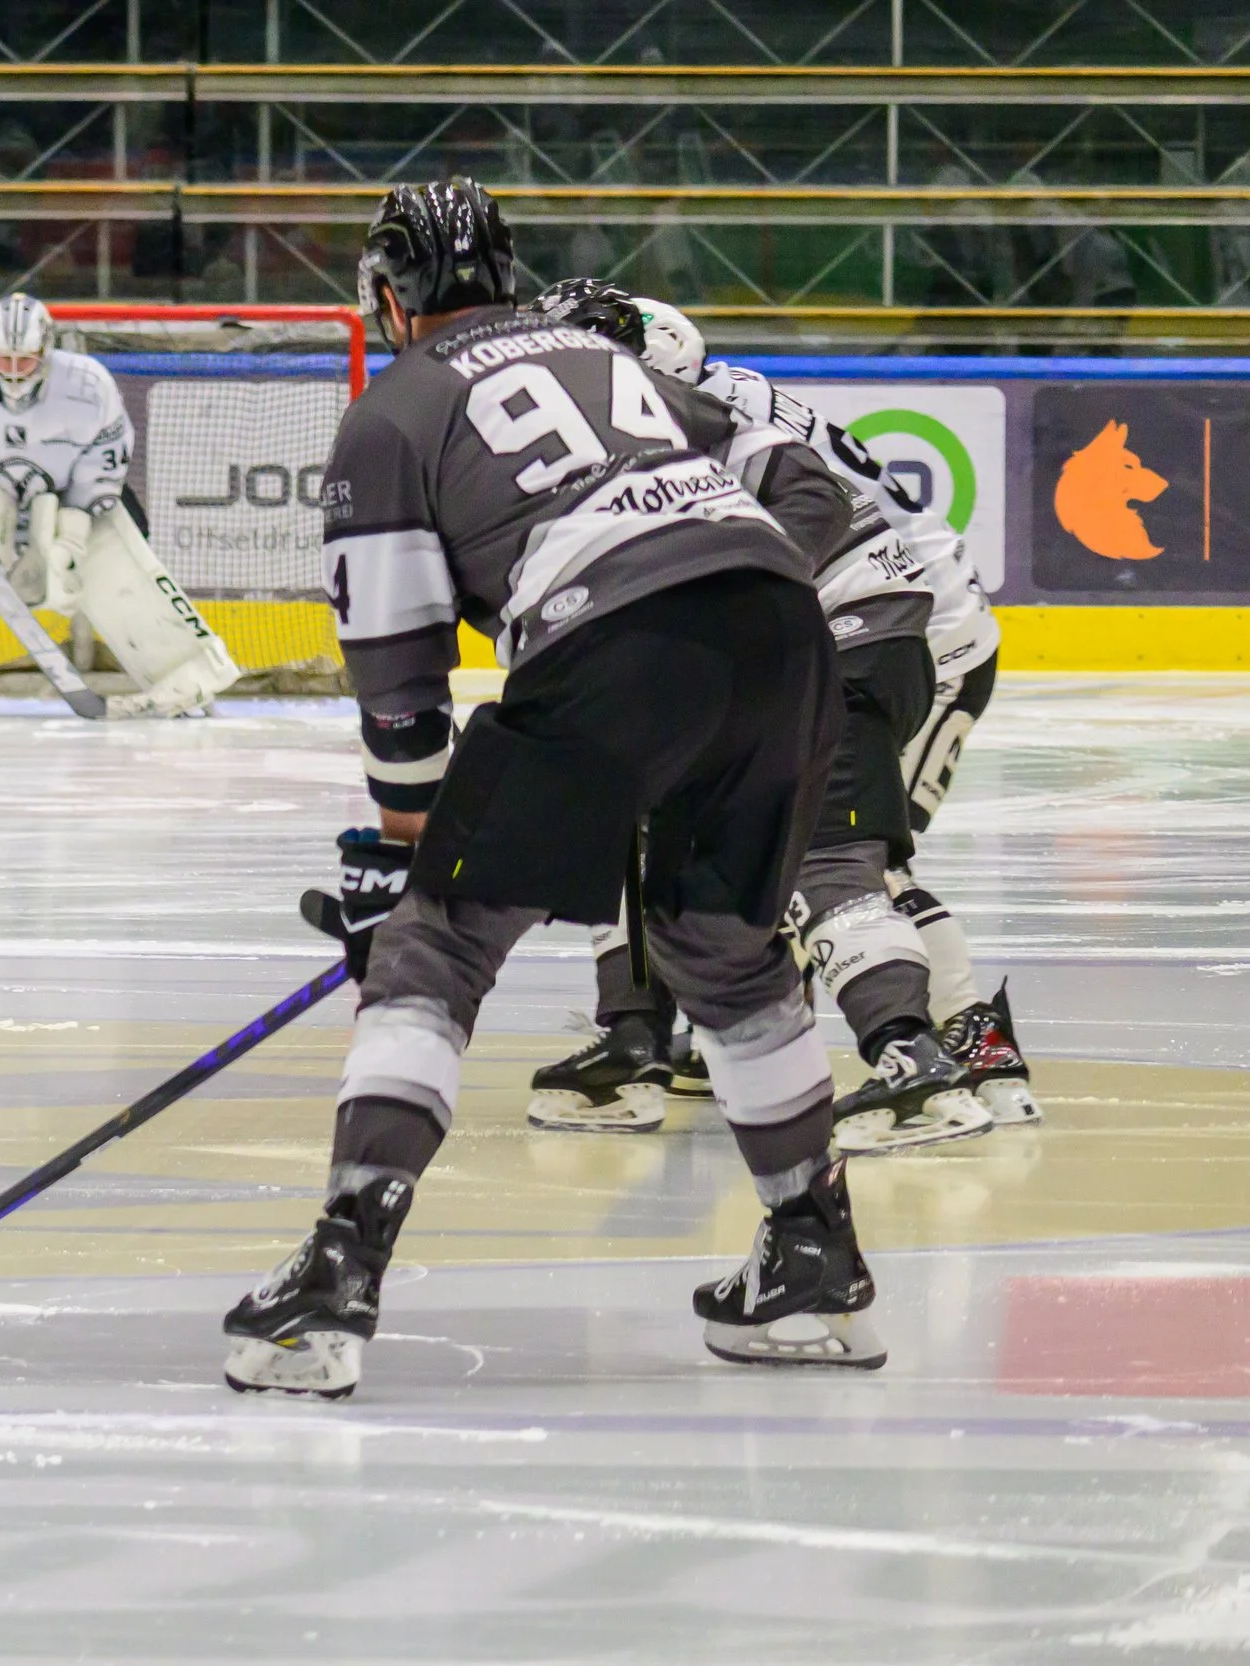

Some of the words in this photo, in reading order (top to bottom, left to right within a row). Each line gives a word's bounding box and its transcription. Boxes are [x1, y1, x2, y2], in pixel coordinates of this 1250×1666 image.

[466, 353, 687, 496] 94
[102, 444, 130, 472] 34
[156, 576, 210, 638] CCM
